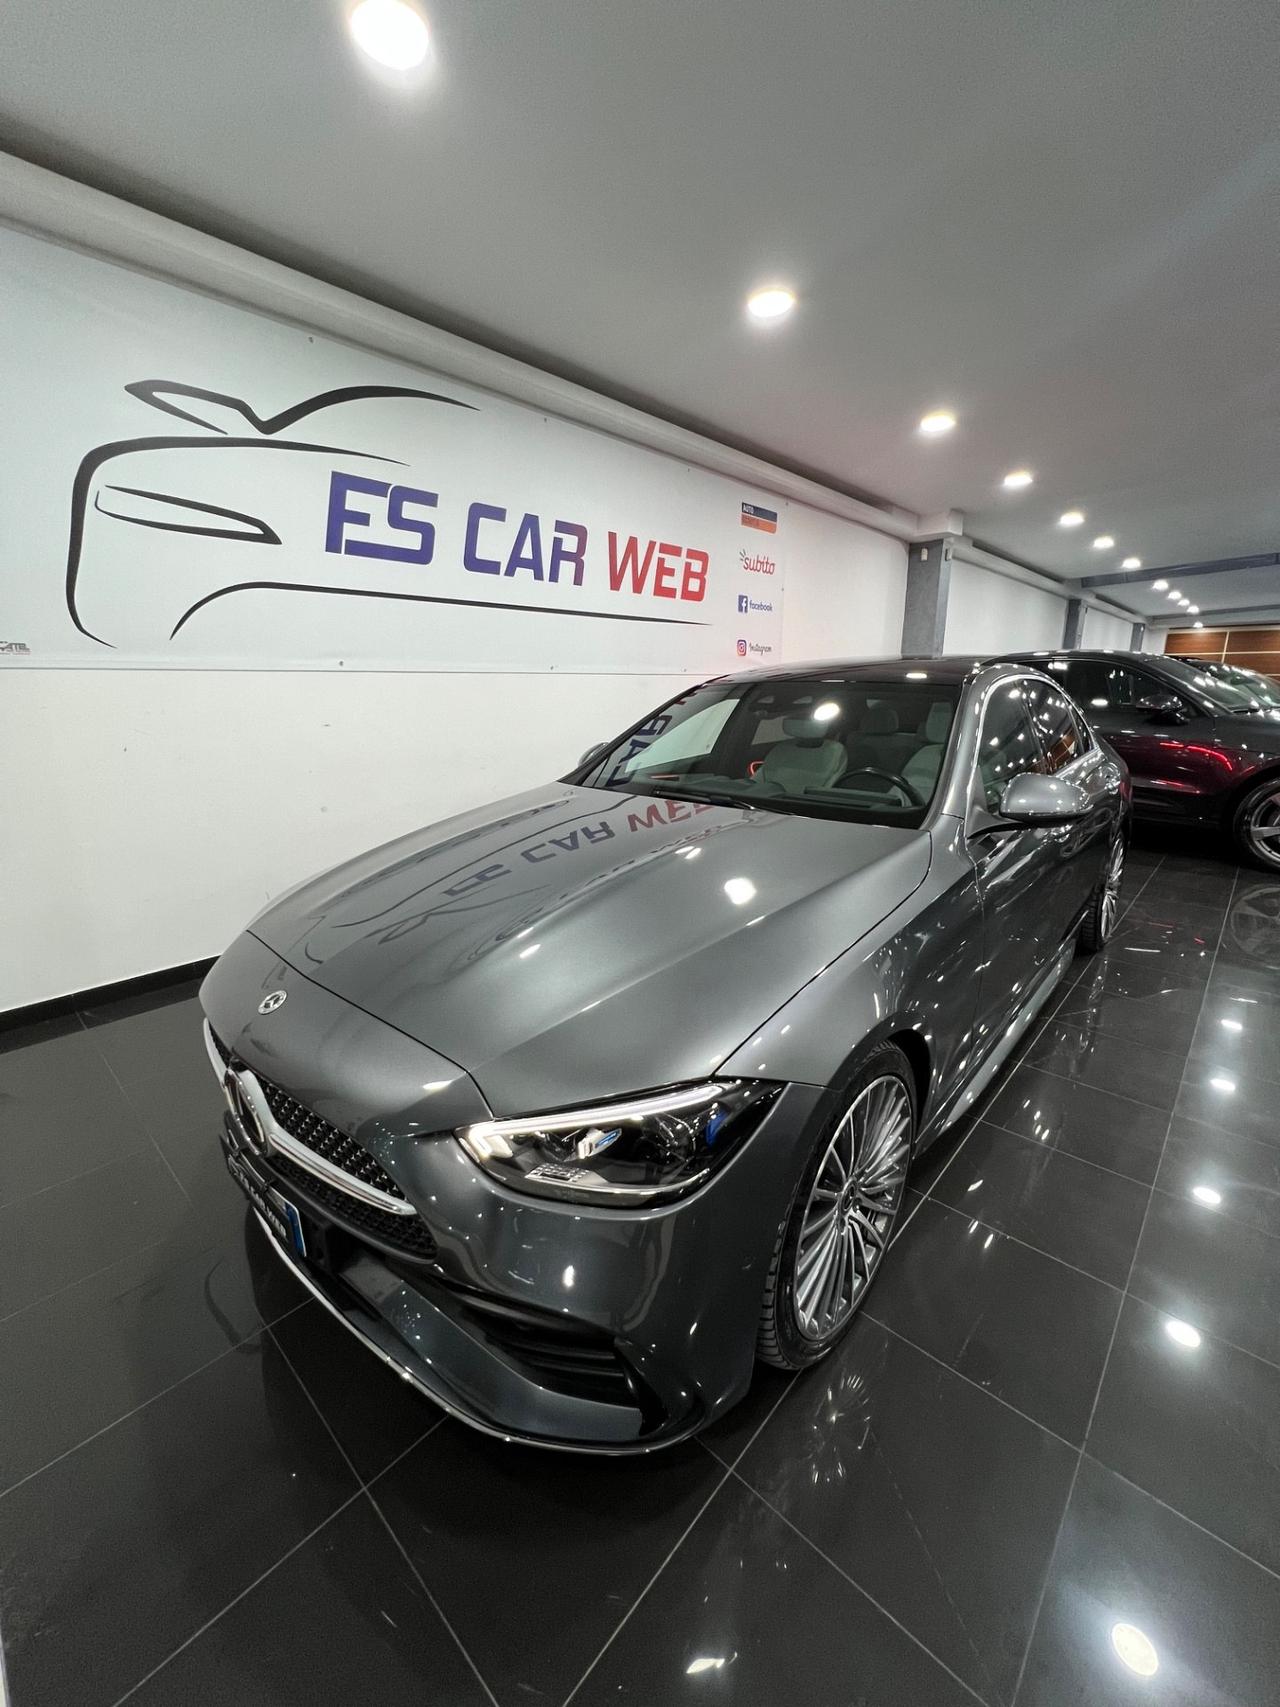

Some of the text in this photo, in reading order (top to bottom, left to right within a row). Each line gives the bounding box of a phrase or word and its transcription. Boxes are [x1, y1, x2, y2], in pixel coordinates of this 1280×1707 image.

[325, 471, 709, 602] ES CAR WEB
[743, 554, 775, 575] subito
[750, 600, 773, 612] facebook
